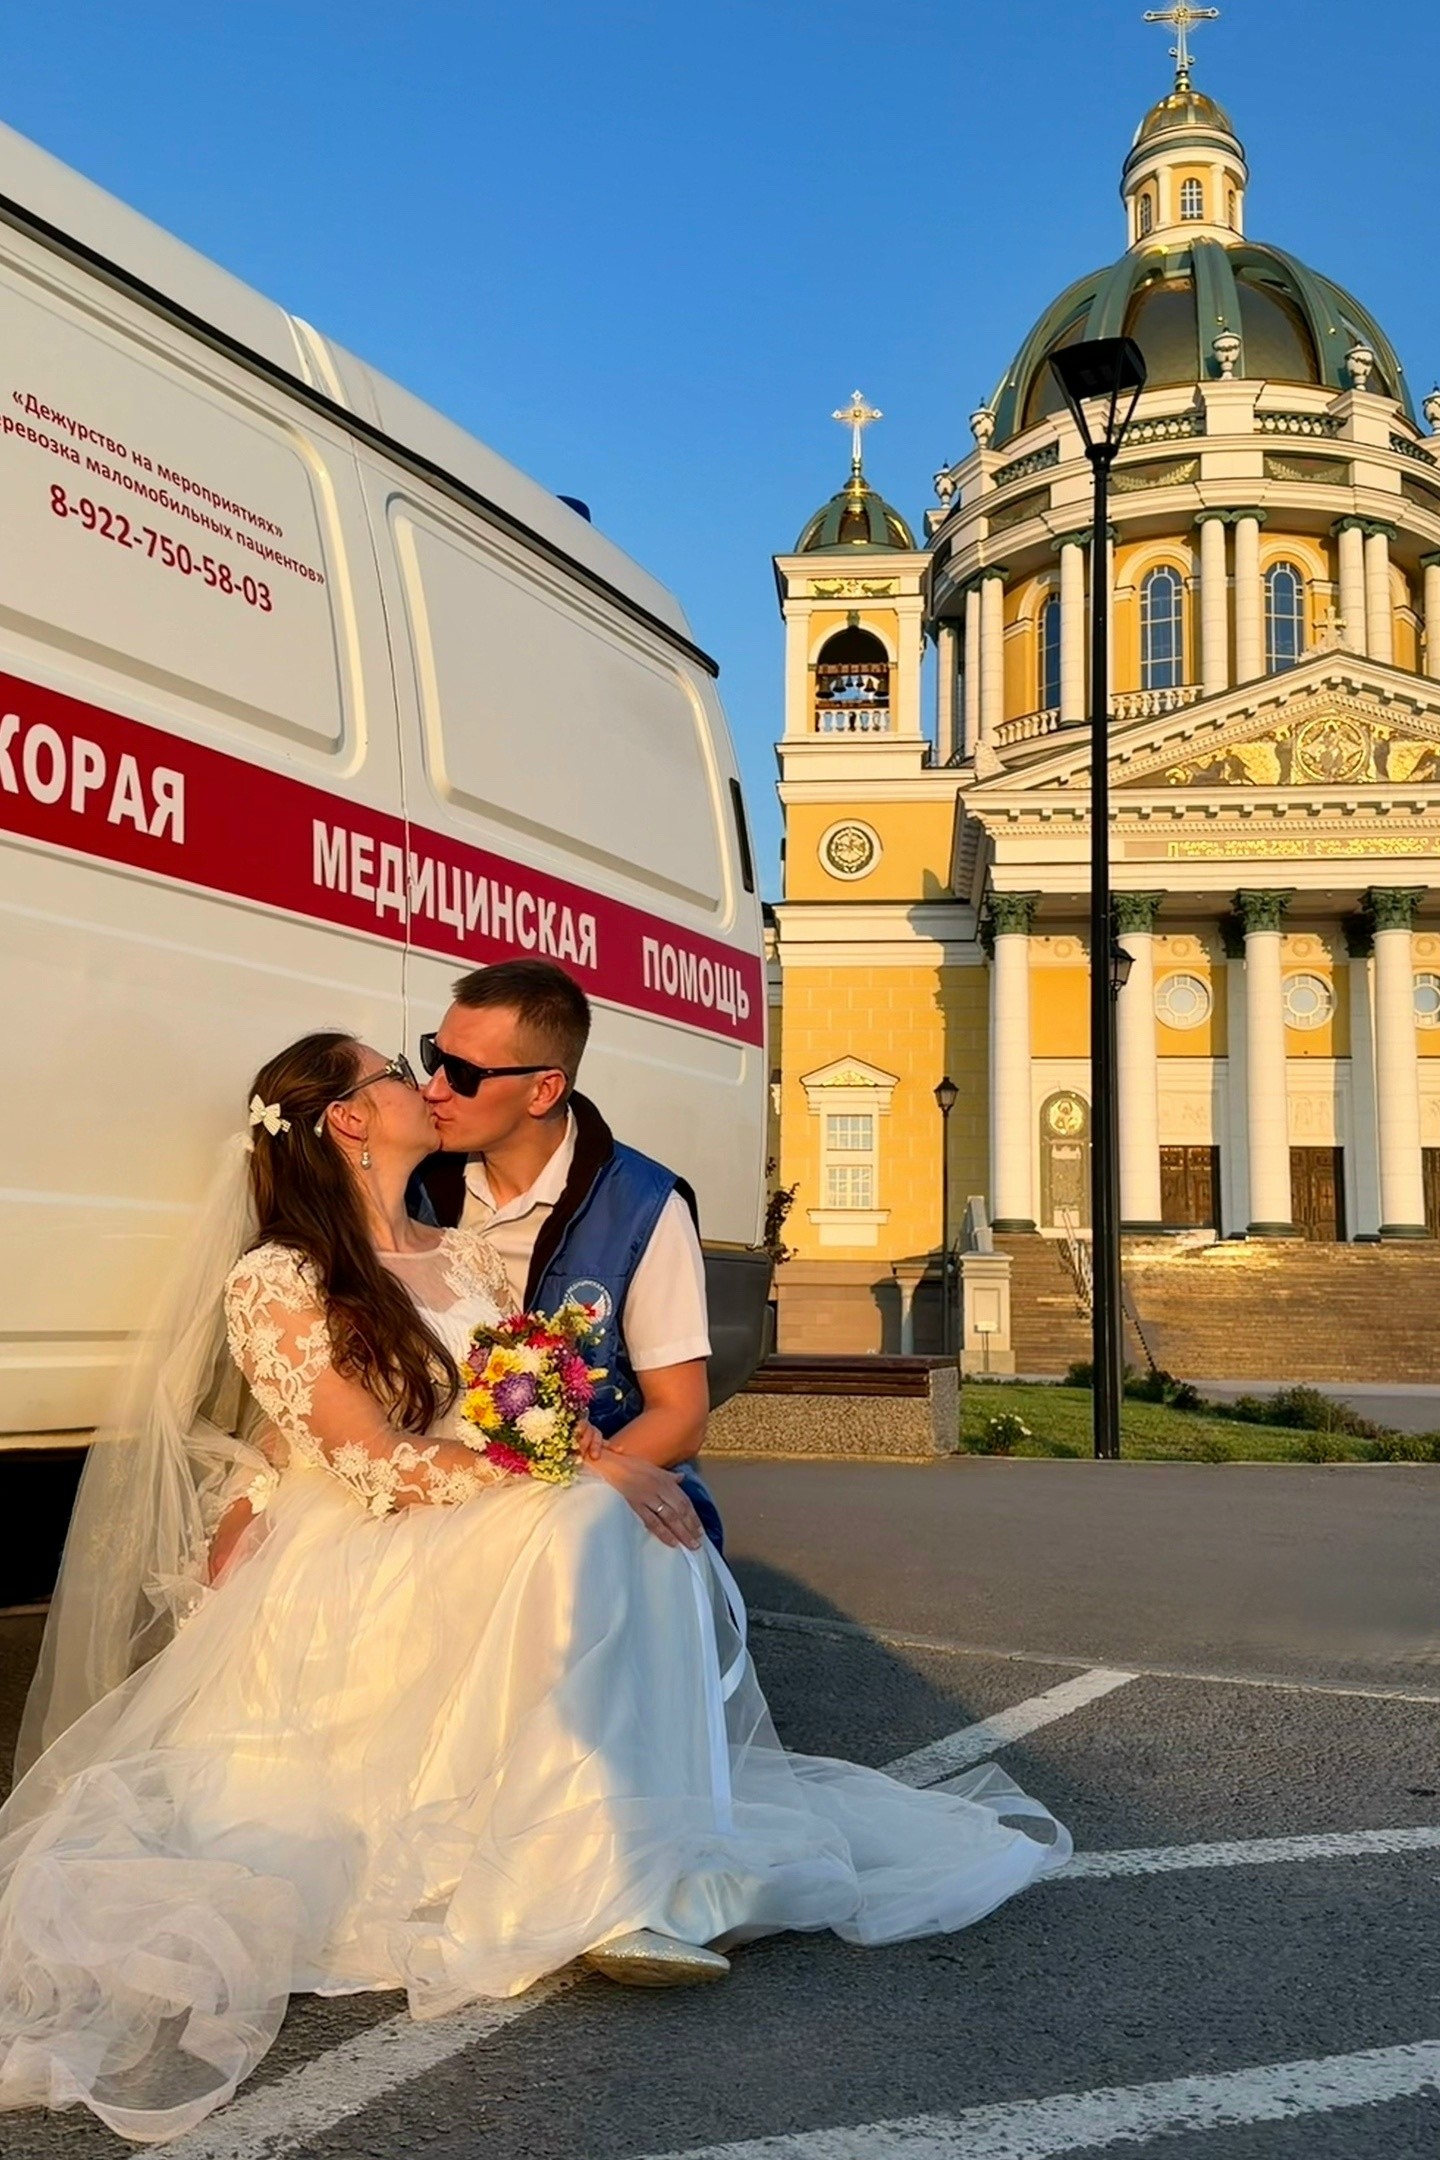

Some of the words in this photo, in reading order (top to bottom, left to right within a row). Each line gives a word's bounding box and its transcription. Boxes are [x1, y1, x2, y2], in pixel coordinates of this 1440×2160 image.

[0, 414, 81, 465] ревозка
[86, 456, 233, 540] маломобильных
[236, 531, 325, 585] пациентов»
[13, 391, 127, 458] «Дежурство
[132, 450, 153, 472] на
[157, 463, 284, 538] мероприятиях»
[50, 483, 273, 613] 8-922-750-58-03
[312, 819, 598, 970] МЕДИЦИНСКАЯ
[642, 935, 750, 1026] ПОМОЩЬ
